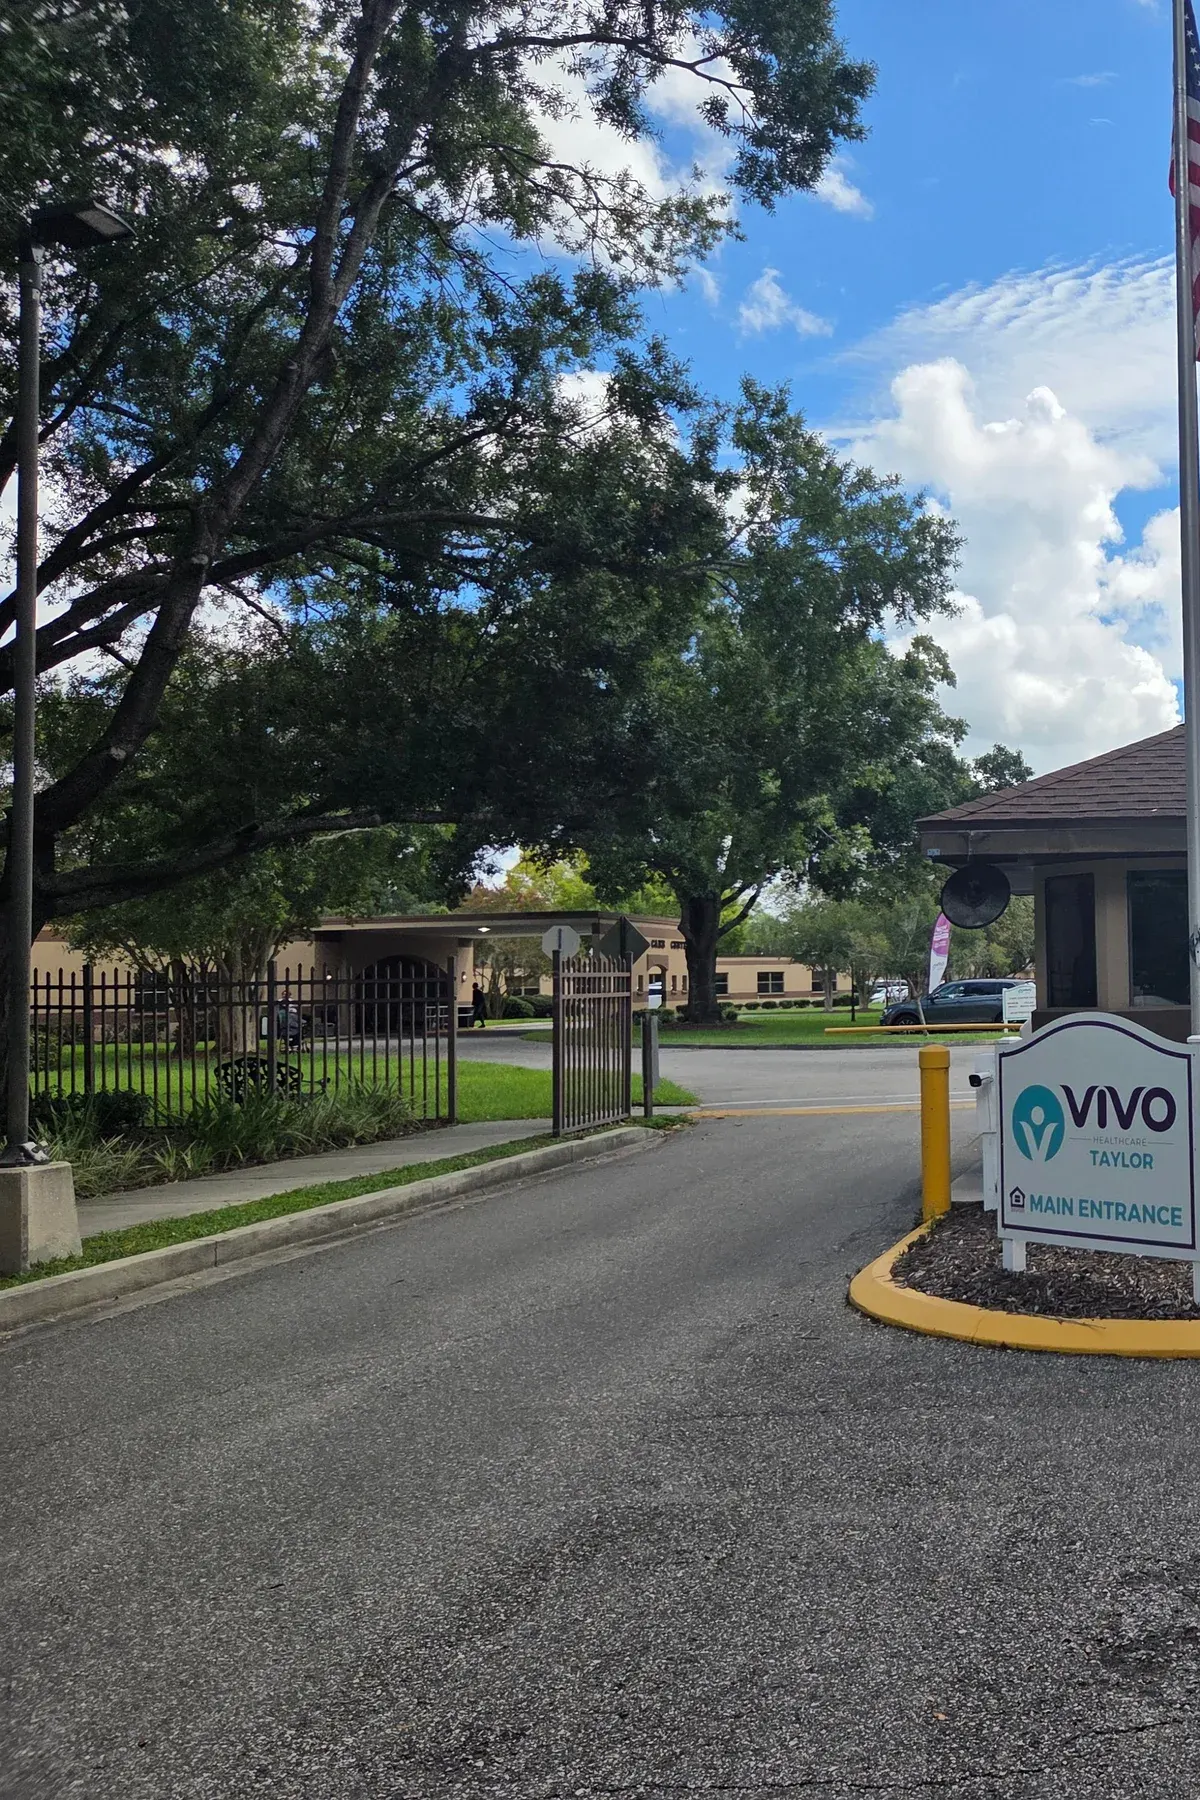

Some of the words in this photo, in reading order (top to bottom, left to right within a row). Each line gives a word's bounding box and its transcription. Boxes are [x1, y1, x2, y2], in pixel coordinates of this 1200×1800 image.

[1059, 1084, 1177, 1132] VIVO
[1093, 1136, 1147, 1146] HEALTHCARE
[1089, 1150, 1153, 1169] TAYLOR
[1030, 1194, 1074, 1216] MAIN
[1078, 1199, 1183, 1226] ENTRANCE
